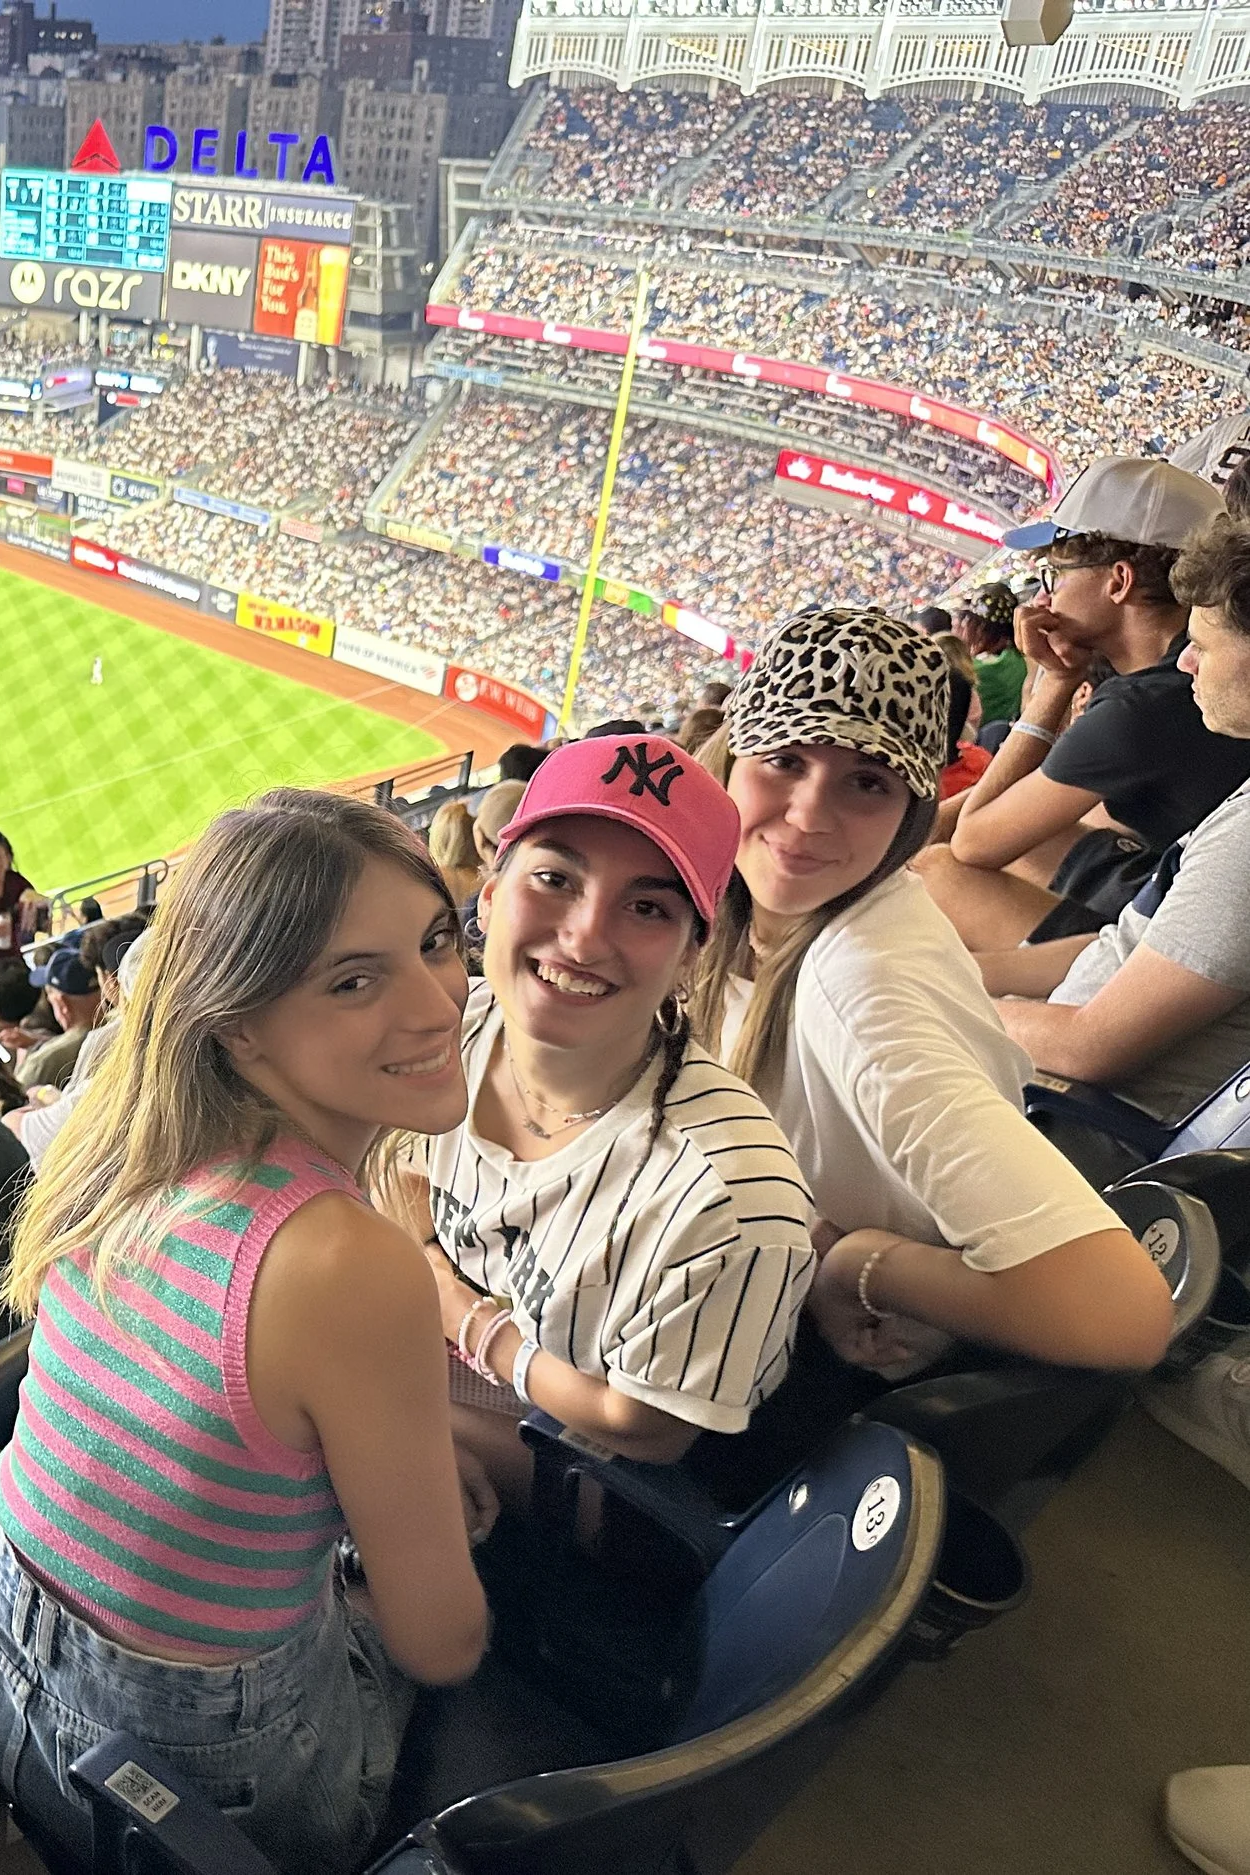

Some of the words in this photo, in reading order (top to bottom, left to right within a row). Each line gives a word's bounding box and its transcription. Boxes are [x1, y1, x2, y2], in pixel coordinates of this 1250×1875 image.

[143, 125, 335, 185] DELTA
[173, 191, 264, 229] STARR
[270, 206, 352, 230] INSURANCE
[53, 268, 144, 311] razr
[172, 260, 252, 297] DKNY
[601, 742, 684, 806] NY
[1148, 1233, 1167, 1261] 12
[866, 1496, 886, 1533] 13
